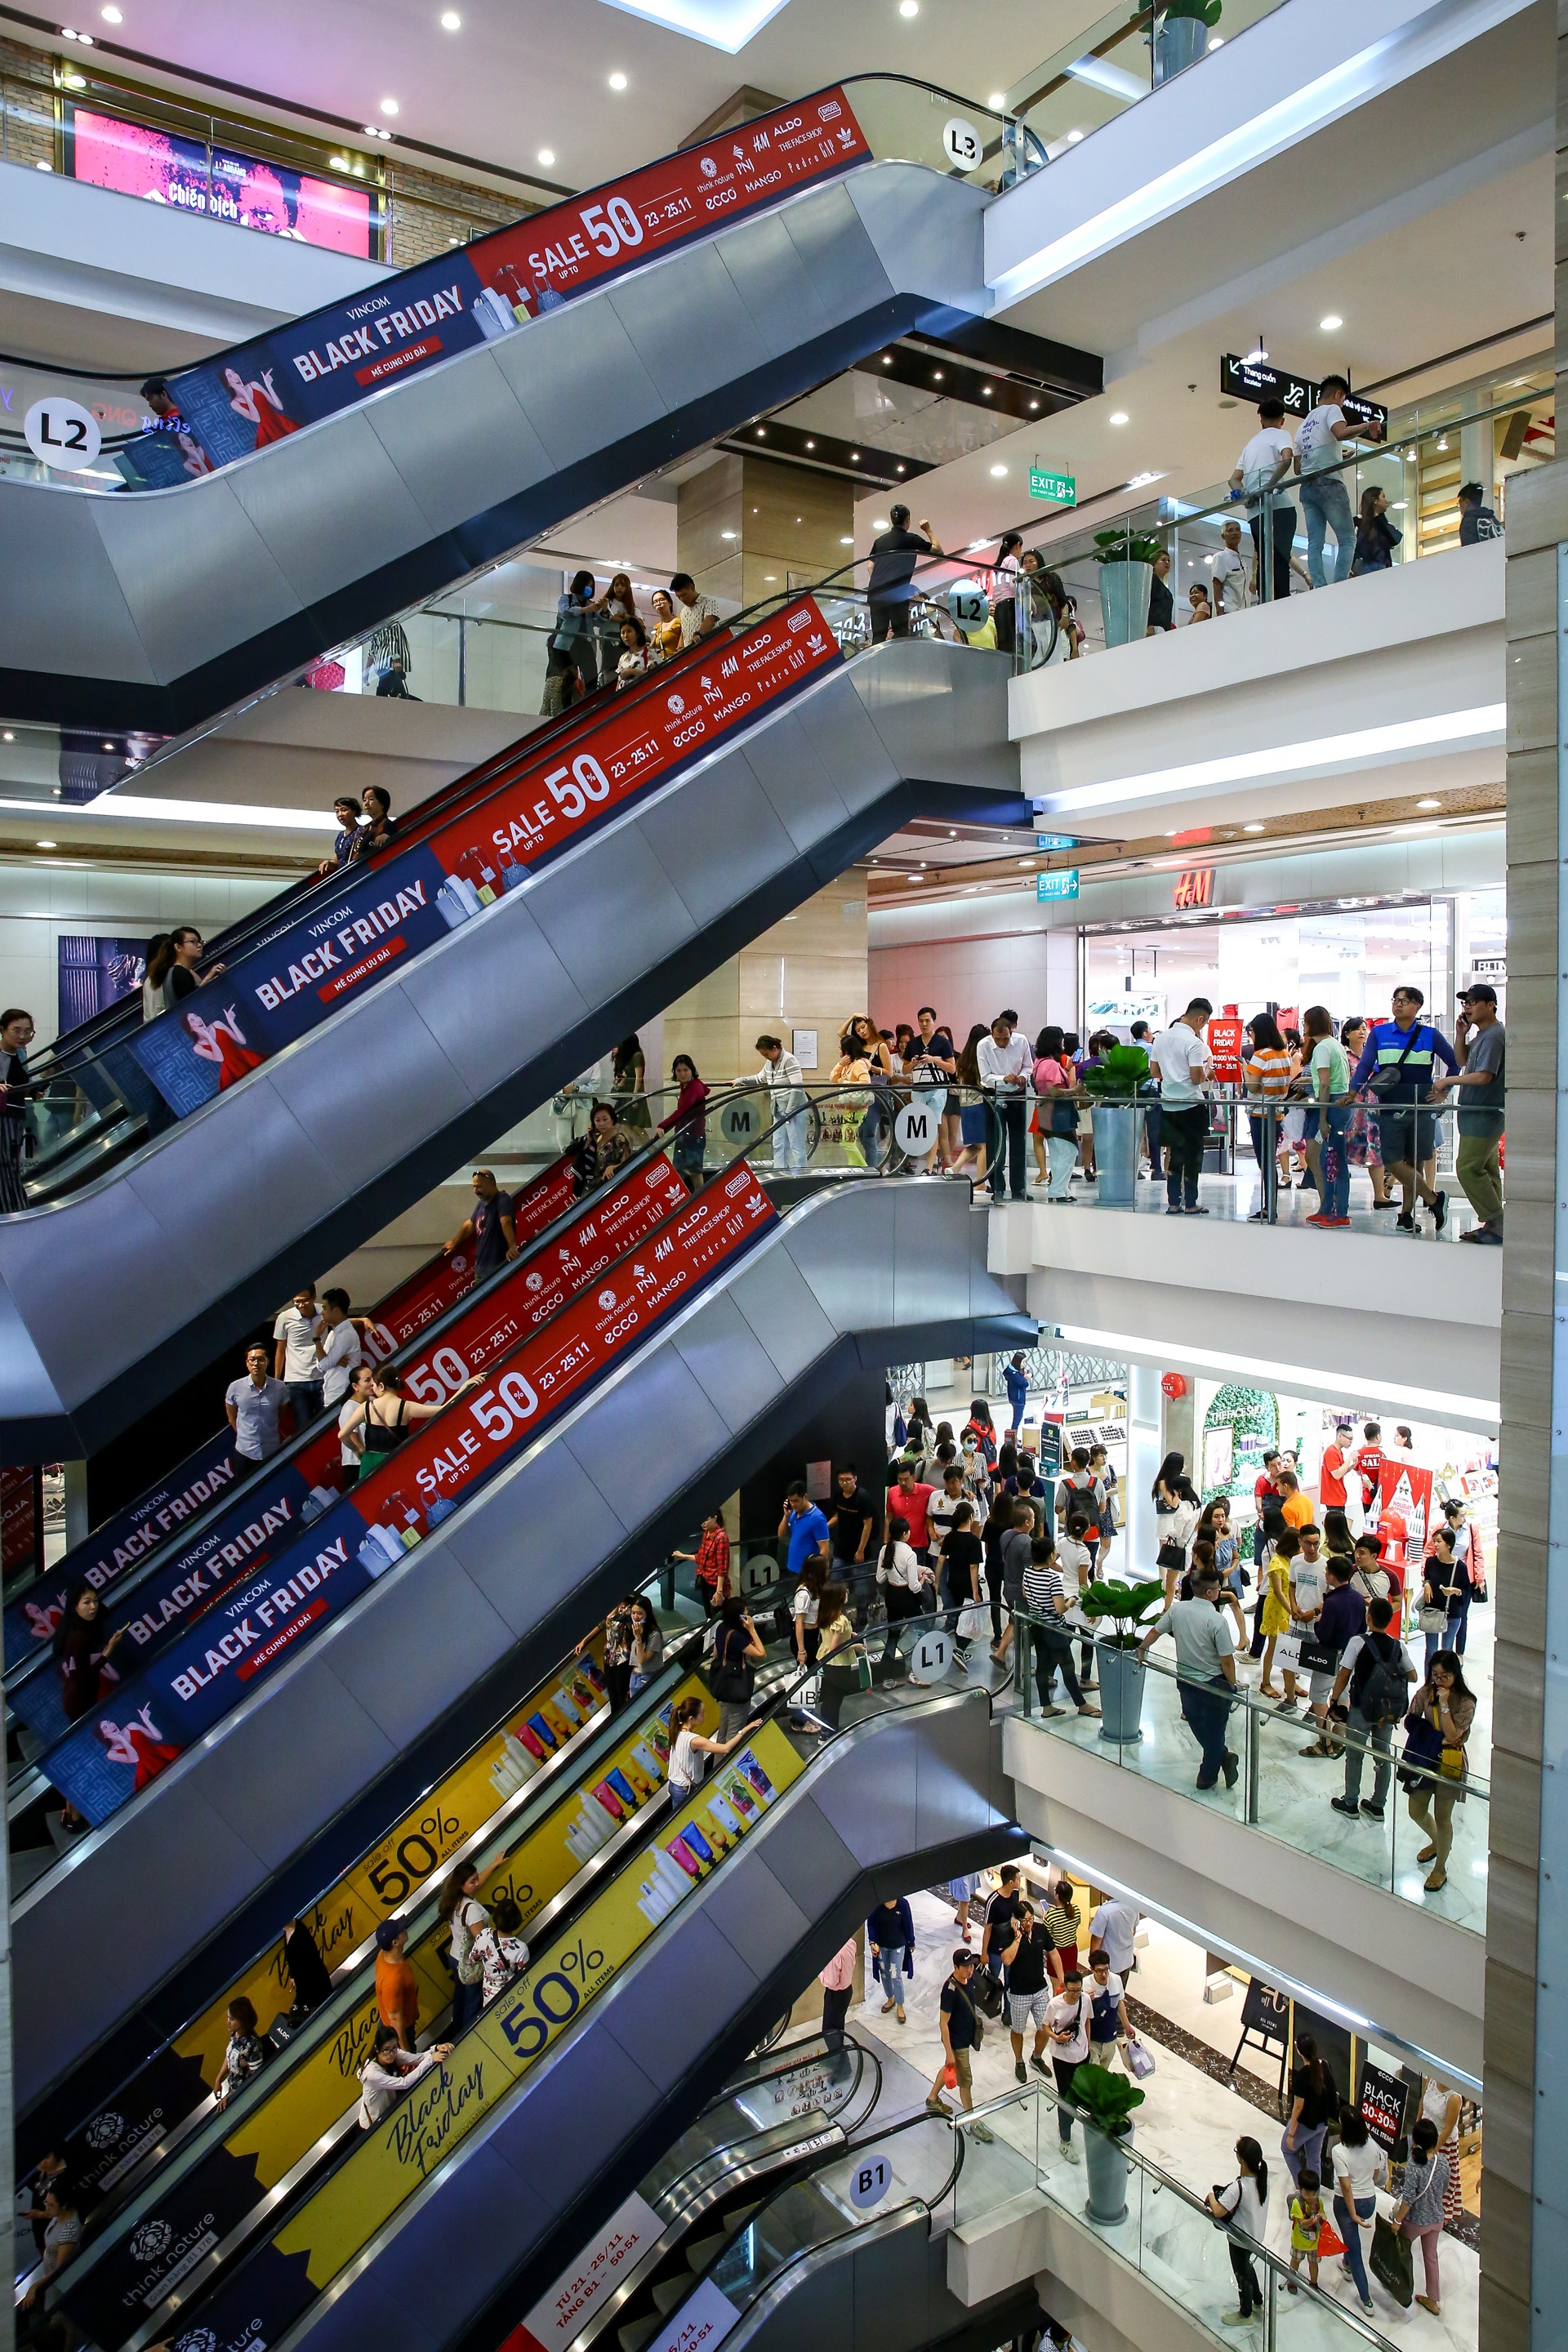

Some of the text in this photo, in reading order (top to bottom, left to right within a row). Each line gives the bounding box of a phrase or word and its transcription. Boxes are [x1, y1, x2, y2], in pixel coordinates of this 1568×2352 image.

[774, 118, 802, 137] ALDO
[818, 139, 835, 159] GAP
[842, 140, 857, 150] adidas
[951, 130, 976, 159] L3
[736, 158, 756, 176] PNJ
[788, 154, 818, 174] Pedro
[697, 172, 735, 194] think nature
[745, 170, 782, 193] MANGO
[644, 197, 693, 227] 23 25.11
[528, 234, 590, 278] SALE
[559, 265, 579, 280] UP TO
[346, 296, 391, 321] VINCOM
[292, 285, 464, 383] BLACK FRIDAY
[383, 357, 403, 372] CUNG
[1244, 365, 1261, 381] Thang
[41, 412, 87, 452] L2
[1031, 474, 1055, 490] EXIT
[957, 595, 981, 621] L2
[742, 634, 772, 659] ALDO
[788, 648, 805, 670] GAP
[812, 644, 827, 657] adidas
[756, 668, 789, 693] Pedro
[703, 686, 724, 706] PNJ
[713, 692, 751, 722] MANGO
[664, 704, 703, 733] think nature
[611, 739, 660, 778] 23 25.11
[492, 800, 555, 853] SALE
[523, 834, 544, 851] UP TO
[1039, 878, 1060, 891] EXIT
[1172, 868, 1213, 908] H&M
[308, 906, 354, 938] VINCOM
[255, 880, 427, 1010] BLACK FRIDAY
[346, 966, 367, 982] CUNG
[1213, 1039, 1235, 1047] FRIDAY
[1214, 1029, 1236, 1037] BLACK
[731, 1111, 751, 1133] M
[906, 1115, 928, 1139] M
[521, 1186, 548, 1211] ALDO
[600, 1195, 629, 1224] ALDO
[647, 1202, 664, 1223] GAP
[751, 1202, 768, 1218] adidas
[677, 1205, 708, 1237] ALDO
[726, 1214, 744, 1236] GAP
[562, 1256, 581, 1276] PNJ
[693, 1236, 726, 1267] Pedro
[572, 1255, 609, 1290] MANGO
[636, 1272, 657, 1294] PNJ
[523, 1294, 541, 1311] think
[647, 1271, 687, 1308] MANGO
[399, 1298, 443, 1339] 23 25.11
[595, 1295, 635, 1331] think nature
[470, 1320, 518, 1364] 23 25.11
[539, 1341, 590, 1390] 23 25.11
[416, 1429, 482, 1492] SALE
[448, 1463, 470, 1484] UP TO
[1361, 1459, 1380, 1467] SAL
[130, 1491, 169, 1521] VINCOM
[84, 1522, 161, 1589] BLACK
[155, 1458, 235, 1531] FRIDAY
[178, 1535, 221, 1570] VINCOM
[127, 1570, 212, 1645] BLACK
[206, 1497, 293, 1579] FRIDAY
[751, 1566, 772, 1588] L1
[225, 1579, 272, 1618] VINCOM
[171, 1619, 261, 1701] BLACK
[255, 1537, 349, 1628] FRIDAY
[922, 1642, 944, 1668] L1
[1280, 1648, 1300, 1659] ALD
[1307, 1655, 1328, 1664] ALDO
[363, 1838, 395, 1873] sale off
[368, 1807, 460, 1905] 50%
[441, 1830, 469, 1859] ALL ITEMS
[583, 1964, 615, 2000] ALL ITEMS
[494, 1976, 532, 2020] sale off
[500, 1938, 604, 2058] 50%
[1378, 2070, 1394, 2083] ecco
[1363, 2093, 1399, 2118] FRIDAY
[1365, 2081, 1401, 2114] BLACK
[386, 2062, 455, 2164] Black
[454, 2100, 491, 2140] NOVEMBER
[78, 2108, 163, 2189] think nature
[1371, 2126, 1394, 2145] ALL ITEMS
[858, 2163, 886, 2194] B1
[122, 2213, 215, 2306] think nature
[571, 2278, 586, 2294] 21
[590, 2233, 623, 2271] 25/11
[583, 2282, 601, 2298] B1
[610, 2234, 640, 2267] 50-51
